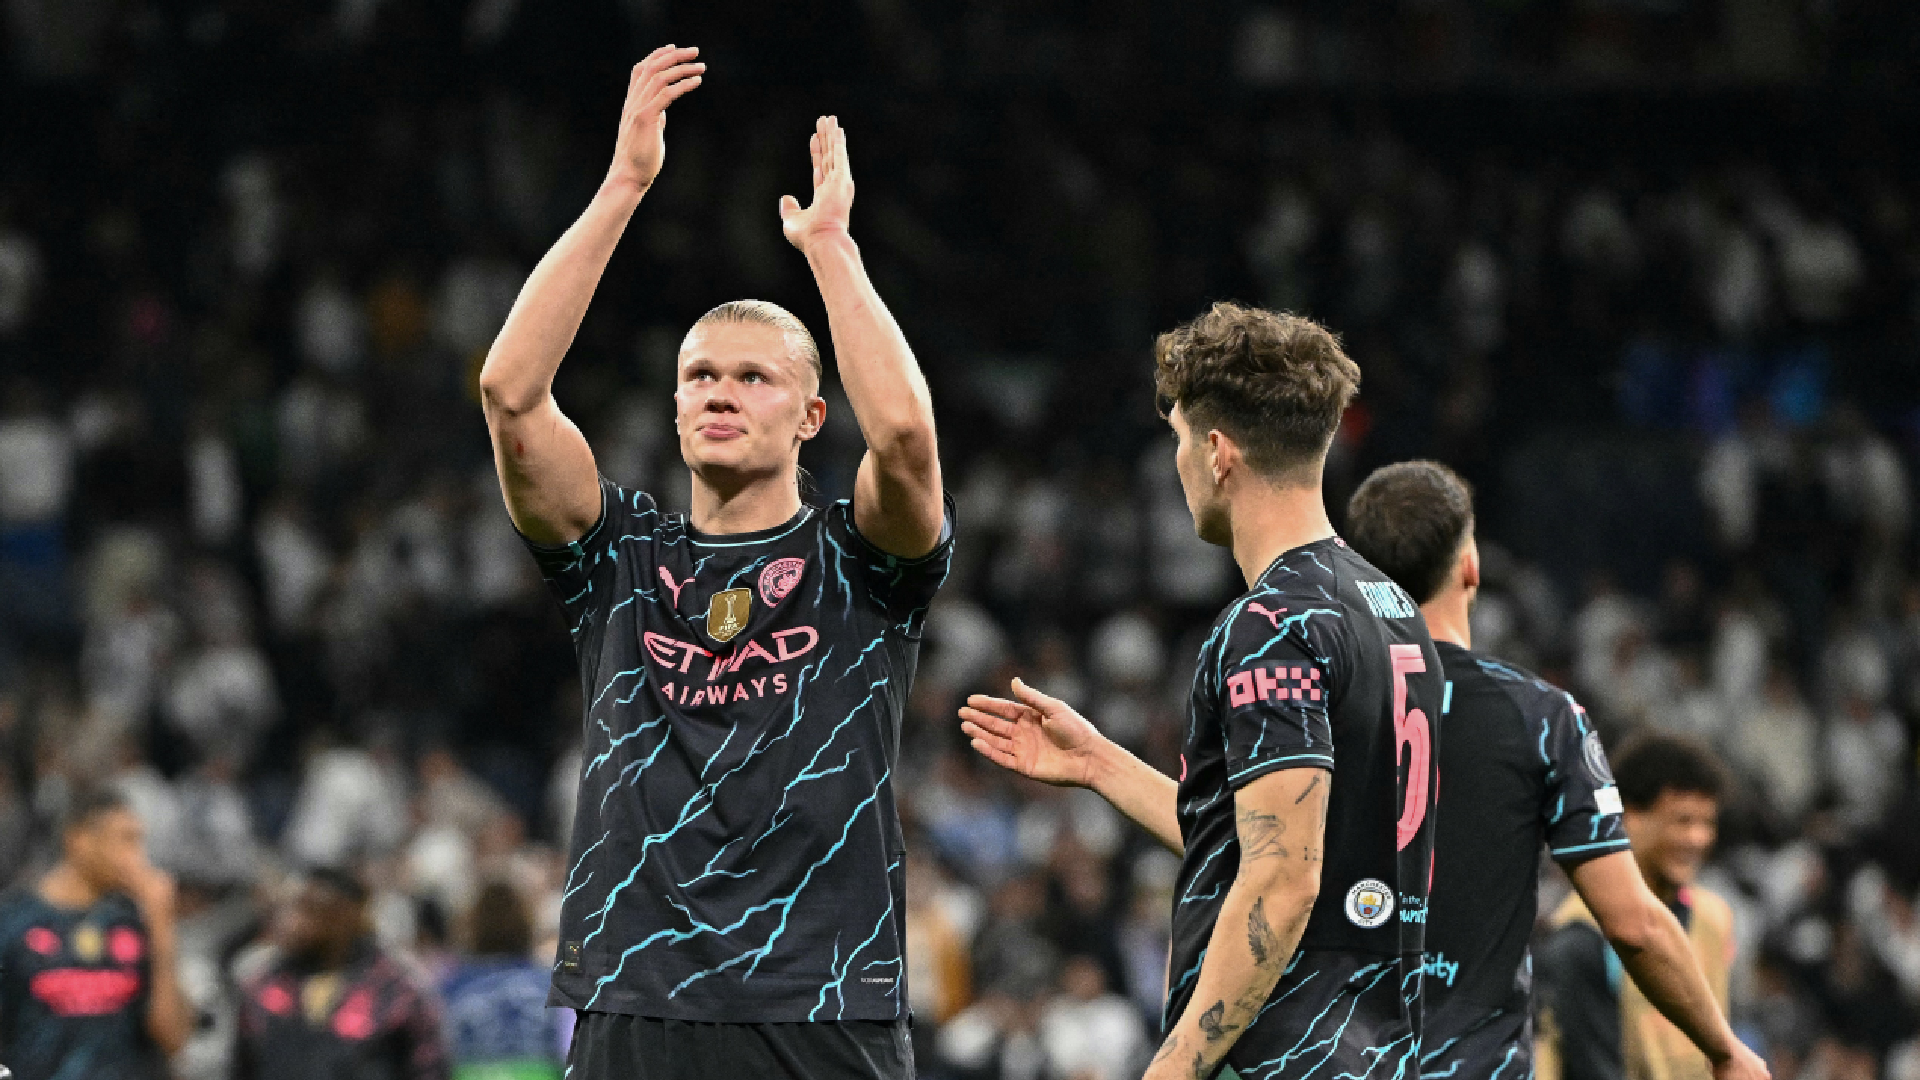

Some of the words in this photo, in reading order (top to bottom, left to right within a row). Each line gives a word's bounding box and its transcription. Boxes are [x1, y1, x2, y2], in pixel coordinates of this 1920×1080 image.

[661, 673, 788, 706] AIRWAYS
[1227, 666, 1320, 708] OKX
[1389, 644, 1430, 851] 5
